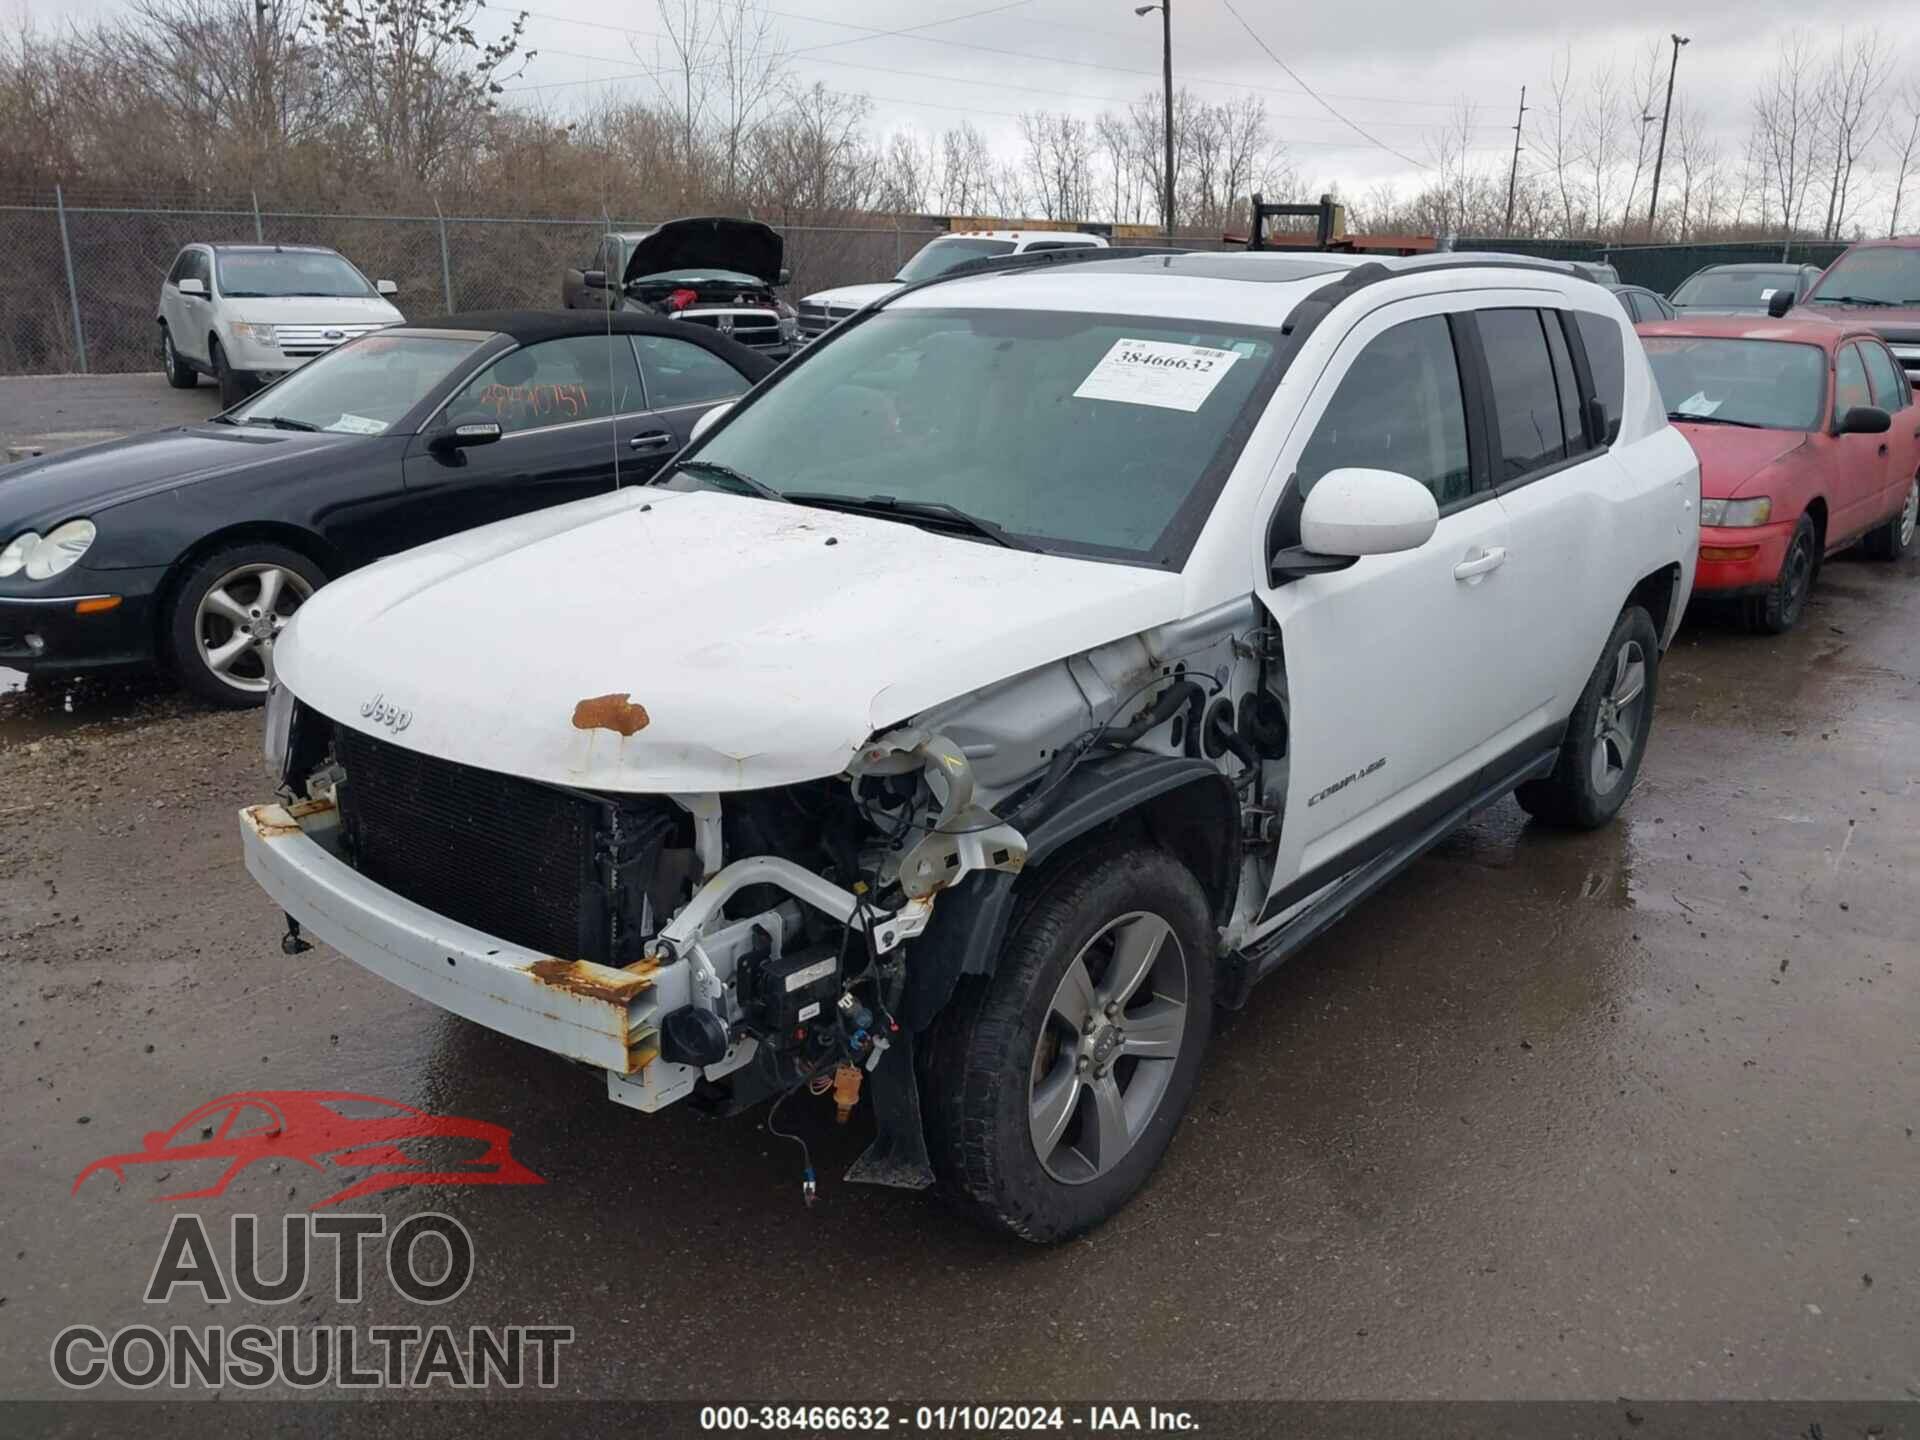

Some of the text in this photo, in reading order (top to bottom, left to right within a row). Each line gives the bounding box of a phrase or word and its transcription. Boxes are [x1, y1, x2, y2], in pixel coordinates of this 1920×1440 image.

[1115, 350, 1214, 373] 38466632
[360, 691, 413, 735] Jeep
[1307, 757, 1386, 807] COMPASS
